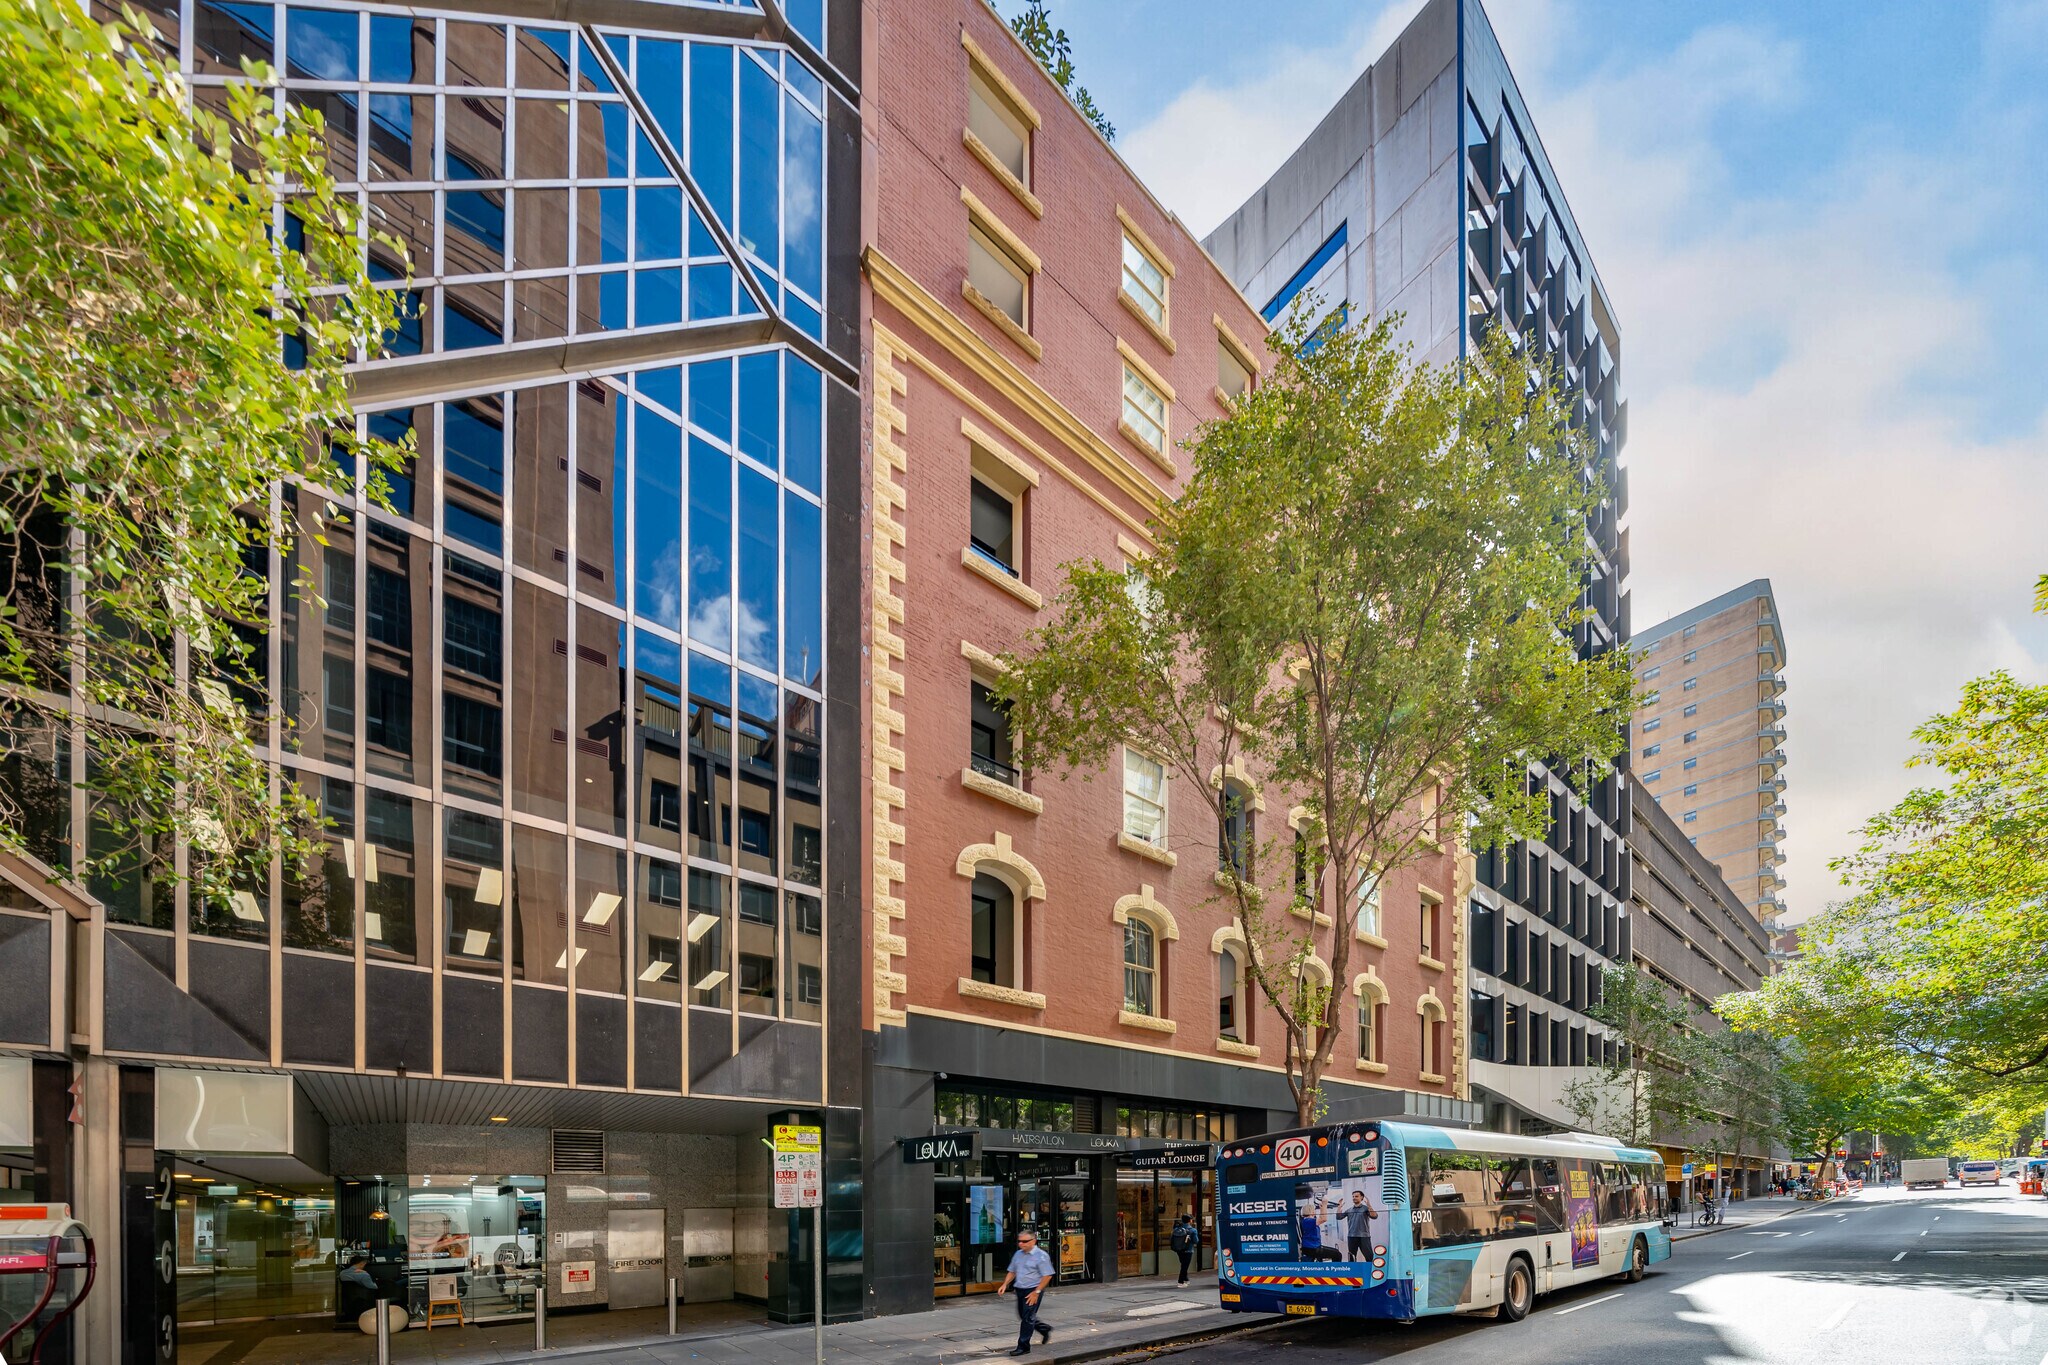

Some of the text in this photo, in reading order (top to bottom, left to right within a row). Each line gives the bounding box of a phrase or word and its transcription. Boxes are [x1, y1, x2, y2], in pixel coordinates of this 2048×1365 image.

[1012, 1134, 1065, 1146] HAIRSALON
[1090, 1138, 1119, 1148] LOUKA
[915, 1140, 959, 1160] LOUKA
[1280, 1145, 1305, 1161] 40
[778, 1154, 795, 1162] 4P
[1136, 1154, 1206, 1165] GUITAR LOUNGE
[1229, 1200, 1287, 1214] KIESER
[1411, 1210, 1432, 1224] 6920
[1240, 1233, 1289, 1242] BACK PAIN
[637, 1258, 664, 1266] DOOR
[709, 1254, 732, 1262] DOOR
[1296, 1305, 1312, 1313] 6920
